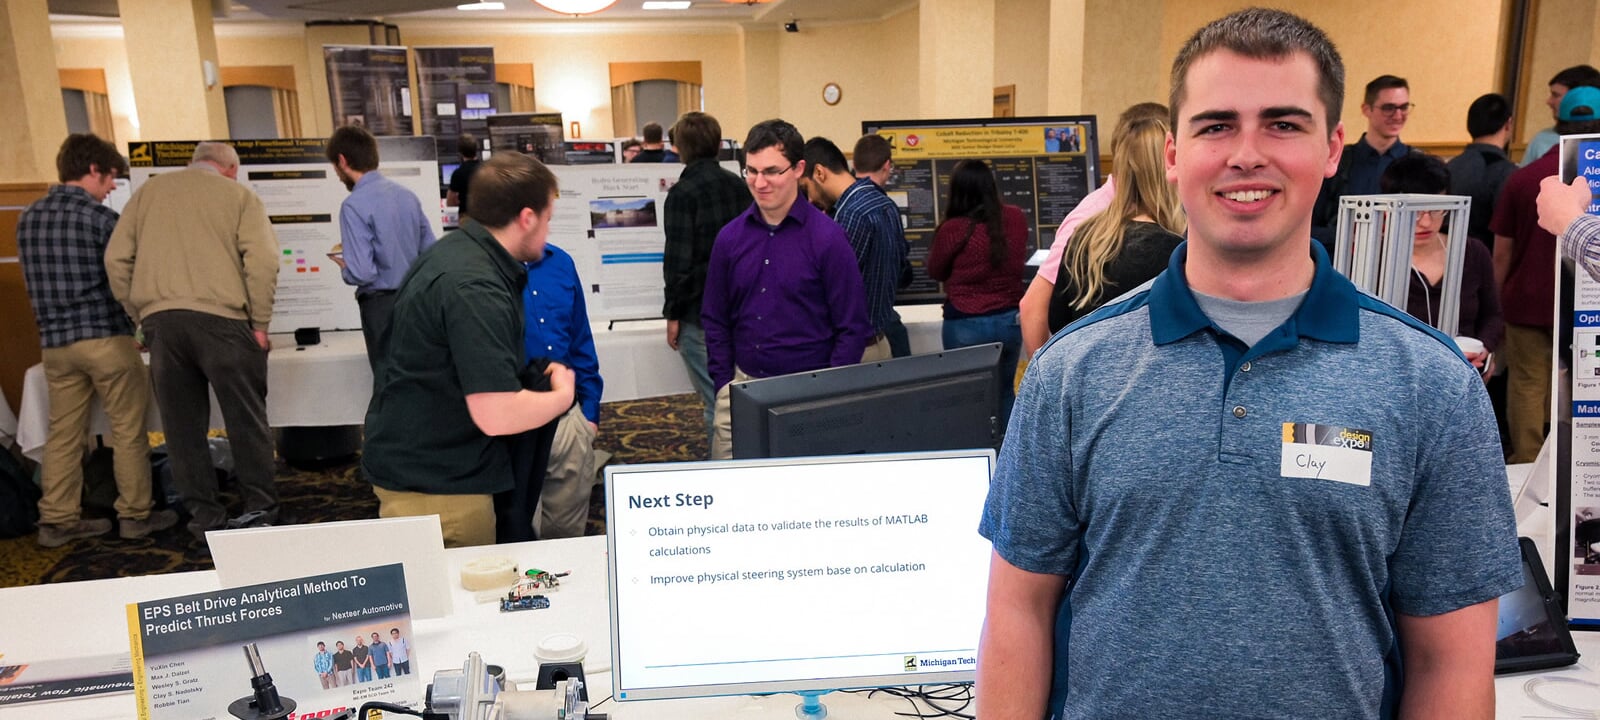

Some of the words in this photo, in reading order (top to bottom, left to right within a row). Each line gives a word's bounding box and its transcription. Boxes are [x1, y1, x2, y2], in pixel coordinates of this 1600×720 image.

[1333, 436, 1365, 449] expo
[1340, 428, 1370, 442] design
[1296, 454, 1326, 479] Clay
[629, 494, 671, 509] Next
[675, 493, 714, 509] Step
[648, 526, 684, 537] Obtain
[687, 523, 728, 537] physical
[732, 522, 755, 533] data
[758, 522, 768, 532] to
[771, 520, 812, 531] validate
[814, 518, 832, 528] the
[834, 517, 869, 527] results
[872, 515, 883, 526] of
[885, 514, 929, 525] MATLAB
[649, 545, 711, 557] calculations
[650, 574, 695, 586] Improve
[697, 571, 739, 584] physical
[742, 569, 784, 581] steering
[787, 568, 824, 580] system
[827, 566, 851, 576] base
[854, 565, 868, 574] on
[870, 562, 926, 573] calculation
[144, 604, 171, 620] EPS
[175, 601, 201, 615] Belt
[204, 597, 237, 611] Drive
[240, 584, 301, 605] Analytical
[303, 577, 348, 595] Method
[350, 575, 367, 587] To
[332, 608, 361, 620] Nexteer
[361, 602, 403, 616] Automotive
[145, 618, 193, 636] Predict
[195, 611, 237, 628] Thrust
[240, 605, 283, 620] Forces
[920, 659, 957, 667] Michigan
[957, 657, 976, 665] Tech
[41, 688, 72, 696] Flow
[152, 682, 174, 690] Wesley
